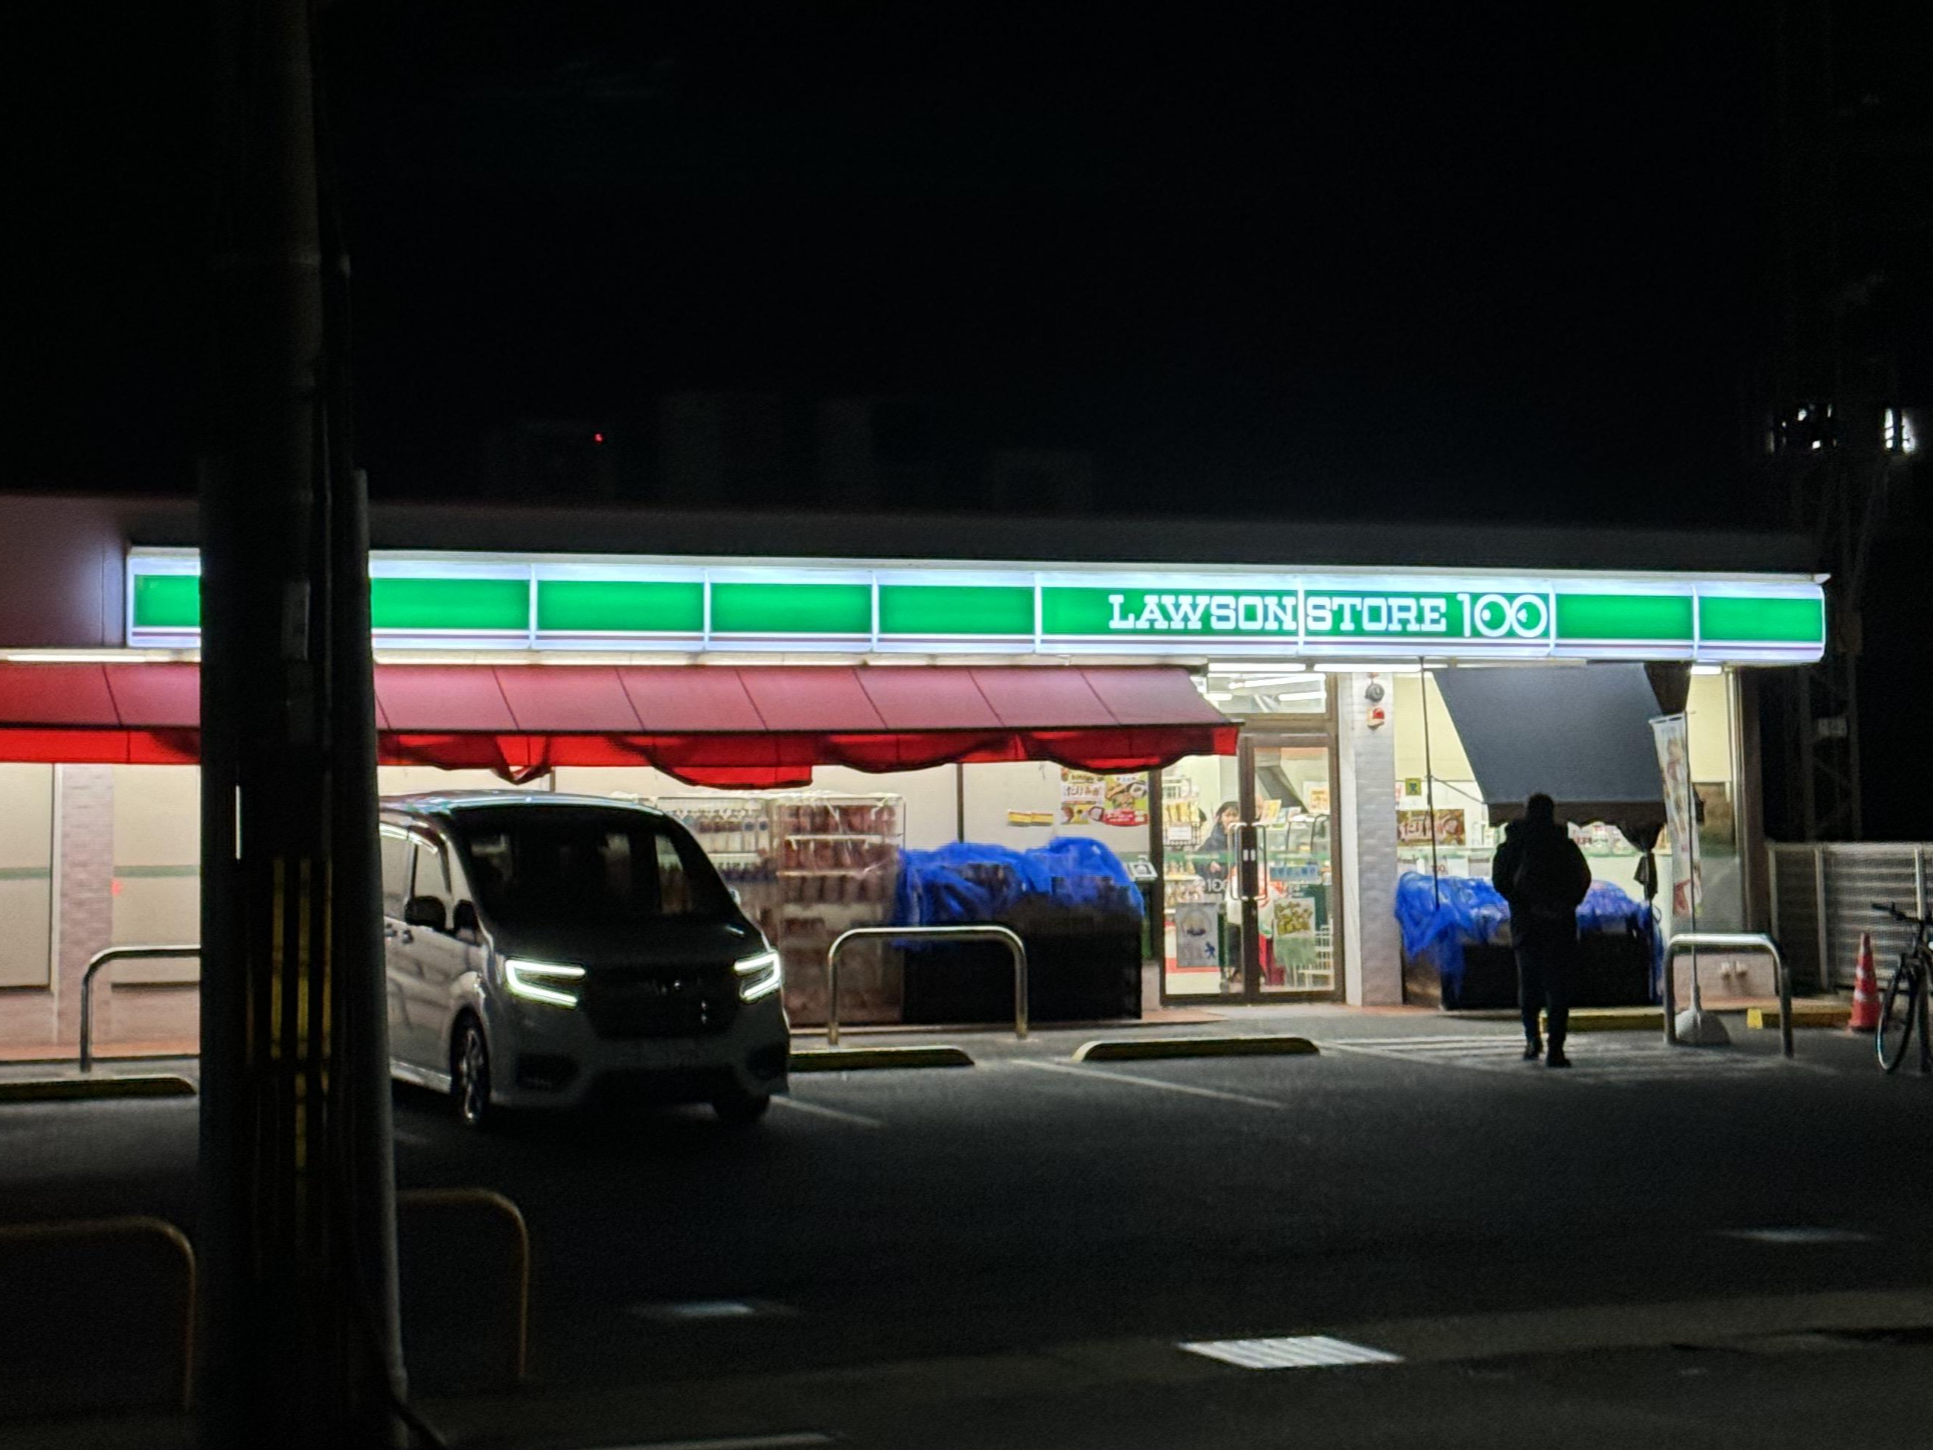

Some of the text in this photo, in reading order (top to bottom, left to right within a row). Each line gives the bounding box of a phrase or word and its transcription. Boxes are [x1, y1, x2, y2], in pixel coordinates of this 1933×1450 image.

[1108, 593, 1549, 638] LAWSON STORE 100
